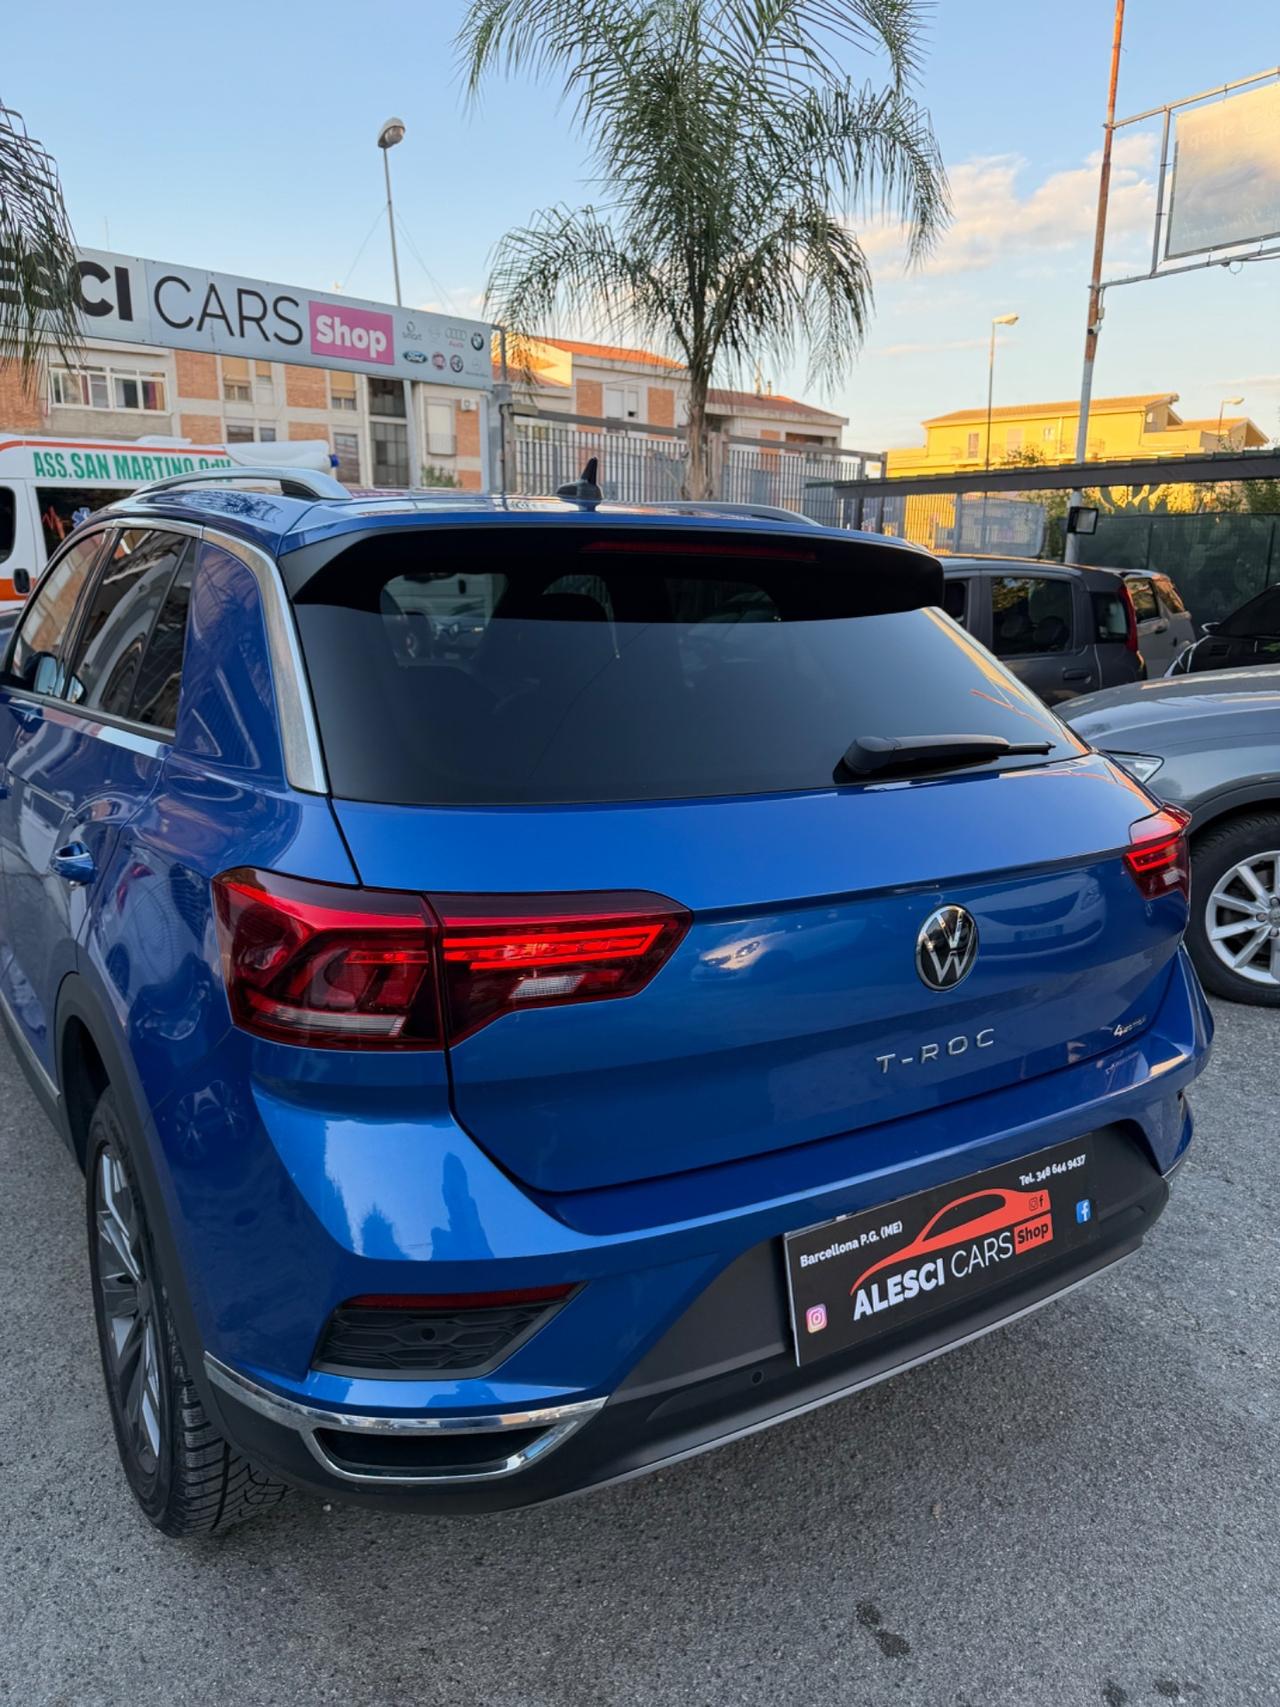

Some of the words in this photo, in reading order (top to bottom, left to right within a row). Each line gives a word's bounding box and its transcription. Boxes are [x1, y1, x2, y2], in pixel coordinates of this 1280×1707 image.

[154, 274, 304, 346] CARS
[315, 313, 387, 358] Shop
[876, 1028, 995, 1074] T-ROC
[1019, 1172, 1036, 1186] Tel.
[1036, 1166, 1051, 1182] 348
[1051, 1162, 1067, 1174] 644
[1067, 1154, 1086, 1170] 9437
[799, 1239, 860, 1268] Barcellona
[860, 1230, 880, 1246] P.G.
[880, 1220, 903, 1239] (ME)
[853, 1258, 945, 1321] ALESCI
[951, 1231, 1013, 1278] CARS
[1017, 1222, 1049, 1245] Shop
